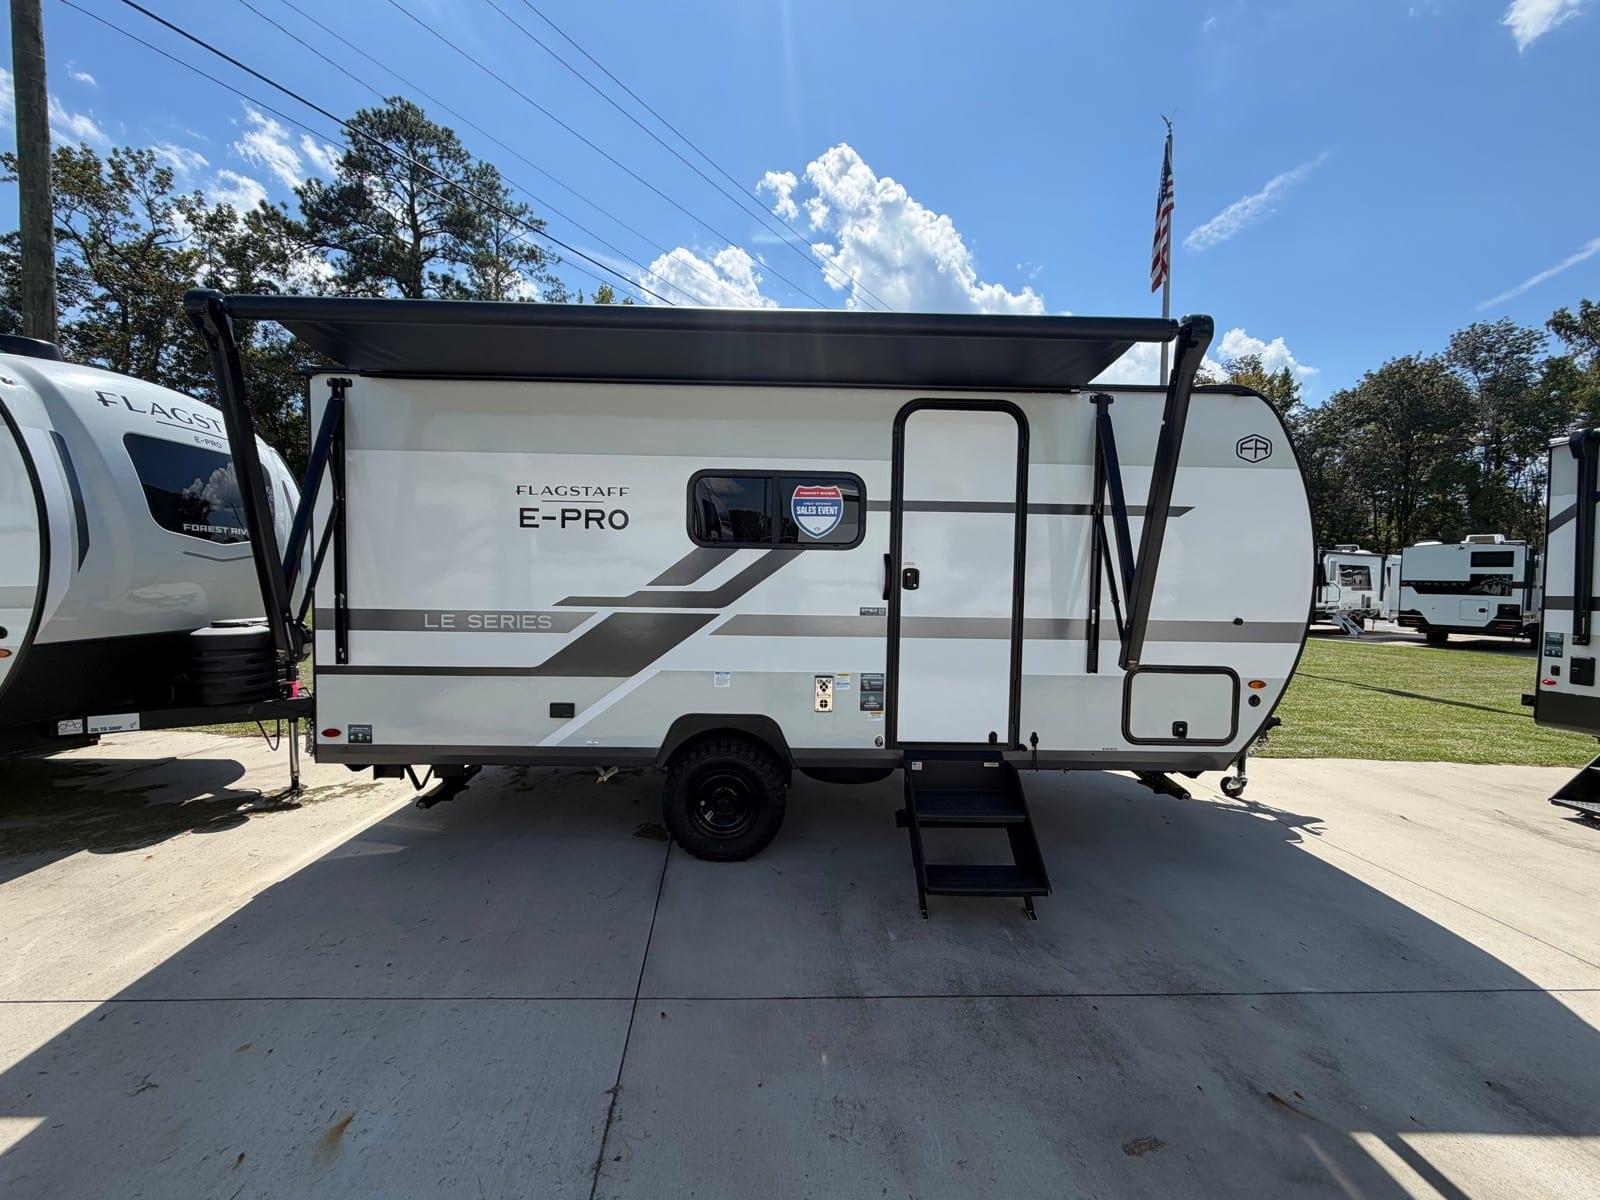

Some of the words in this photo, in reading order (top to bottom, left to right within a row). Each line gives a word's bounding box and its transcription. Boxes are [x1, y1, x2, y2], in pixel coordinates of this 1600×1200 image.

[94, 390, 223, 433] FLAGST
[193, 435, 223, 449] E-PRO
[515, 485, 630, 497] FLAGSTAFF
[796, 506, 817, 515] SALES
[817, 506, 838, 515] EVENT
[519, 507, 629, 530] E-PRO
[183, 524, 229, 534] FOREST
[230, 527, 249, 538] RIV
[424, 613, 455, 628] LE
[467, 614, 552, 629] SERIES
